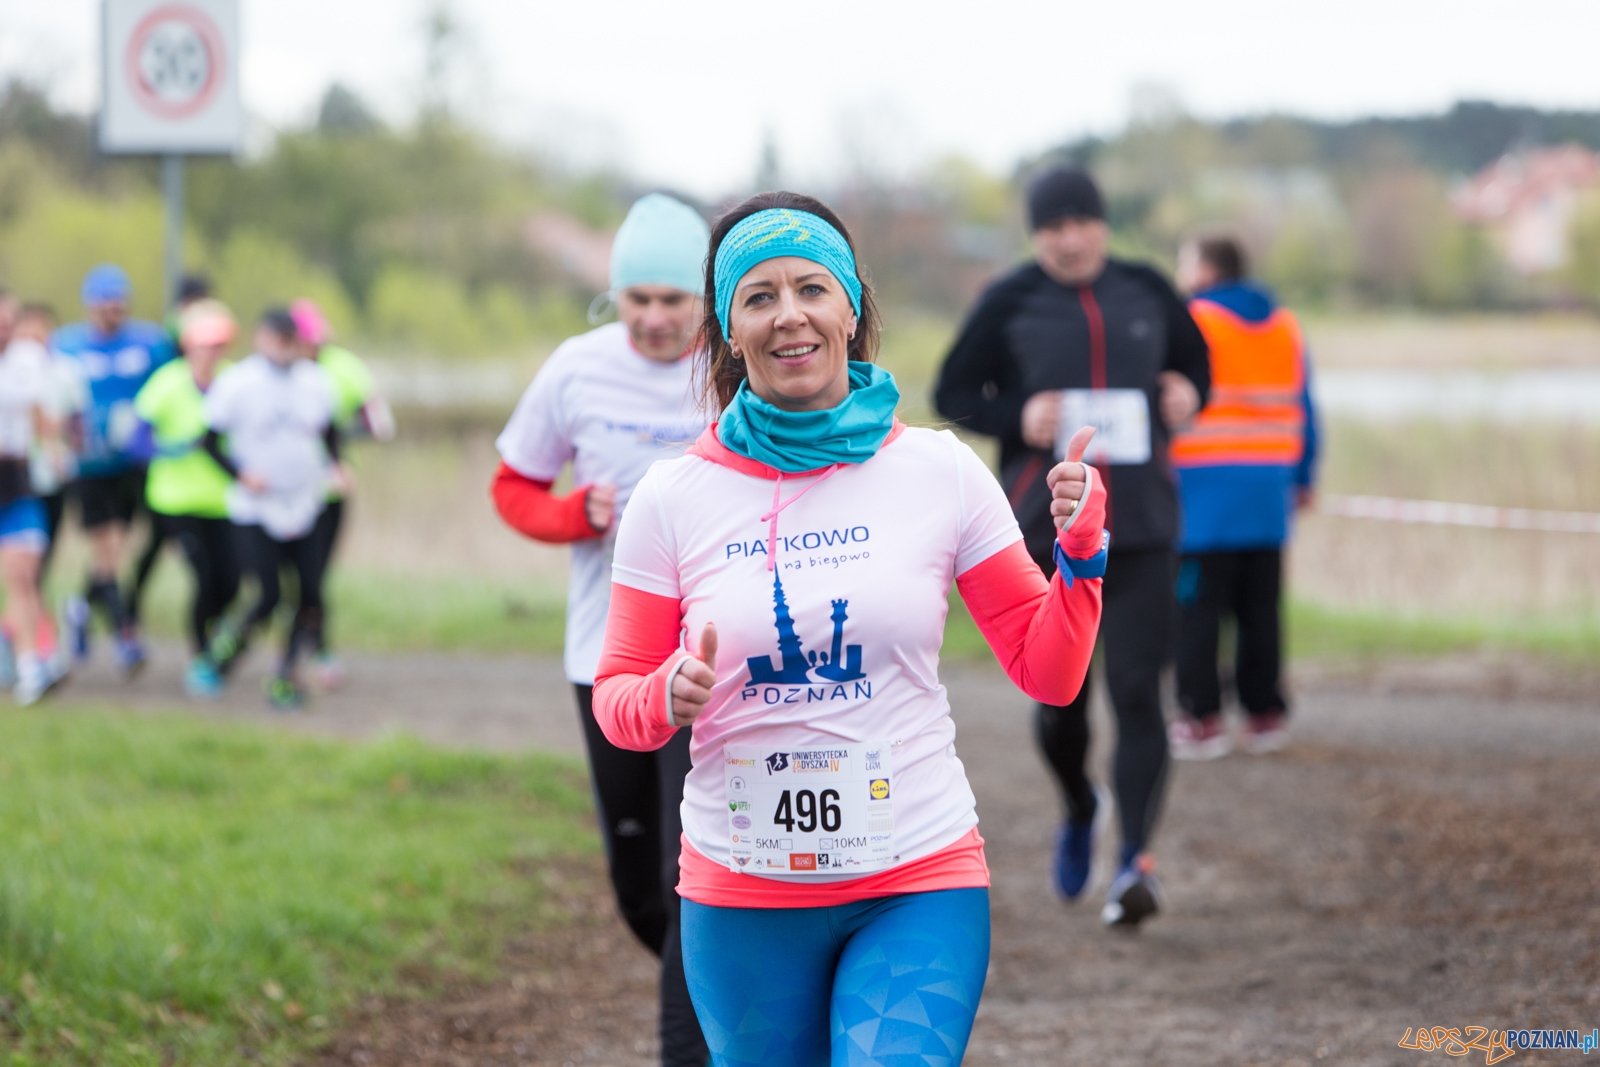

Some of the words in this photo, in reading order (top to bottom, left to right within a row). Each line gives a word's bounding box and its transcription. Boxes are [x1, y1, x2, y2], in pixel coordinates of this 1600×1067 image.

[784, 560, 802, 570] na
[810, 551, 870, 569] biegowo
[742, 680, 871, 704] POZNAŃ
[792, 750, 848, 760] UNIWERSYTECKA
[792, 760, 829, 769] ZADYSZKA
[830, 759, 840, 772] IV
[774, 789, 841, 833] 496
[756, 838, 779, 849] 5KM
[834, 837, 867, 849] 10KM
